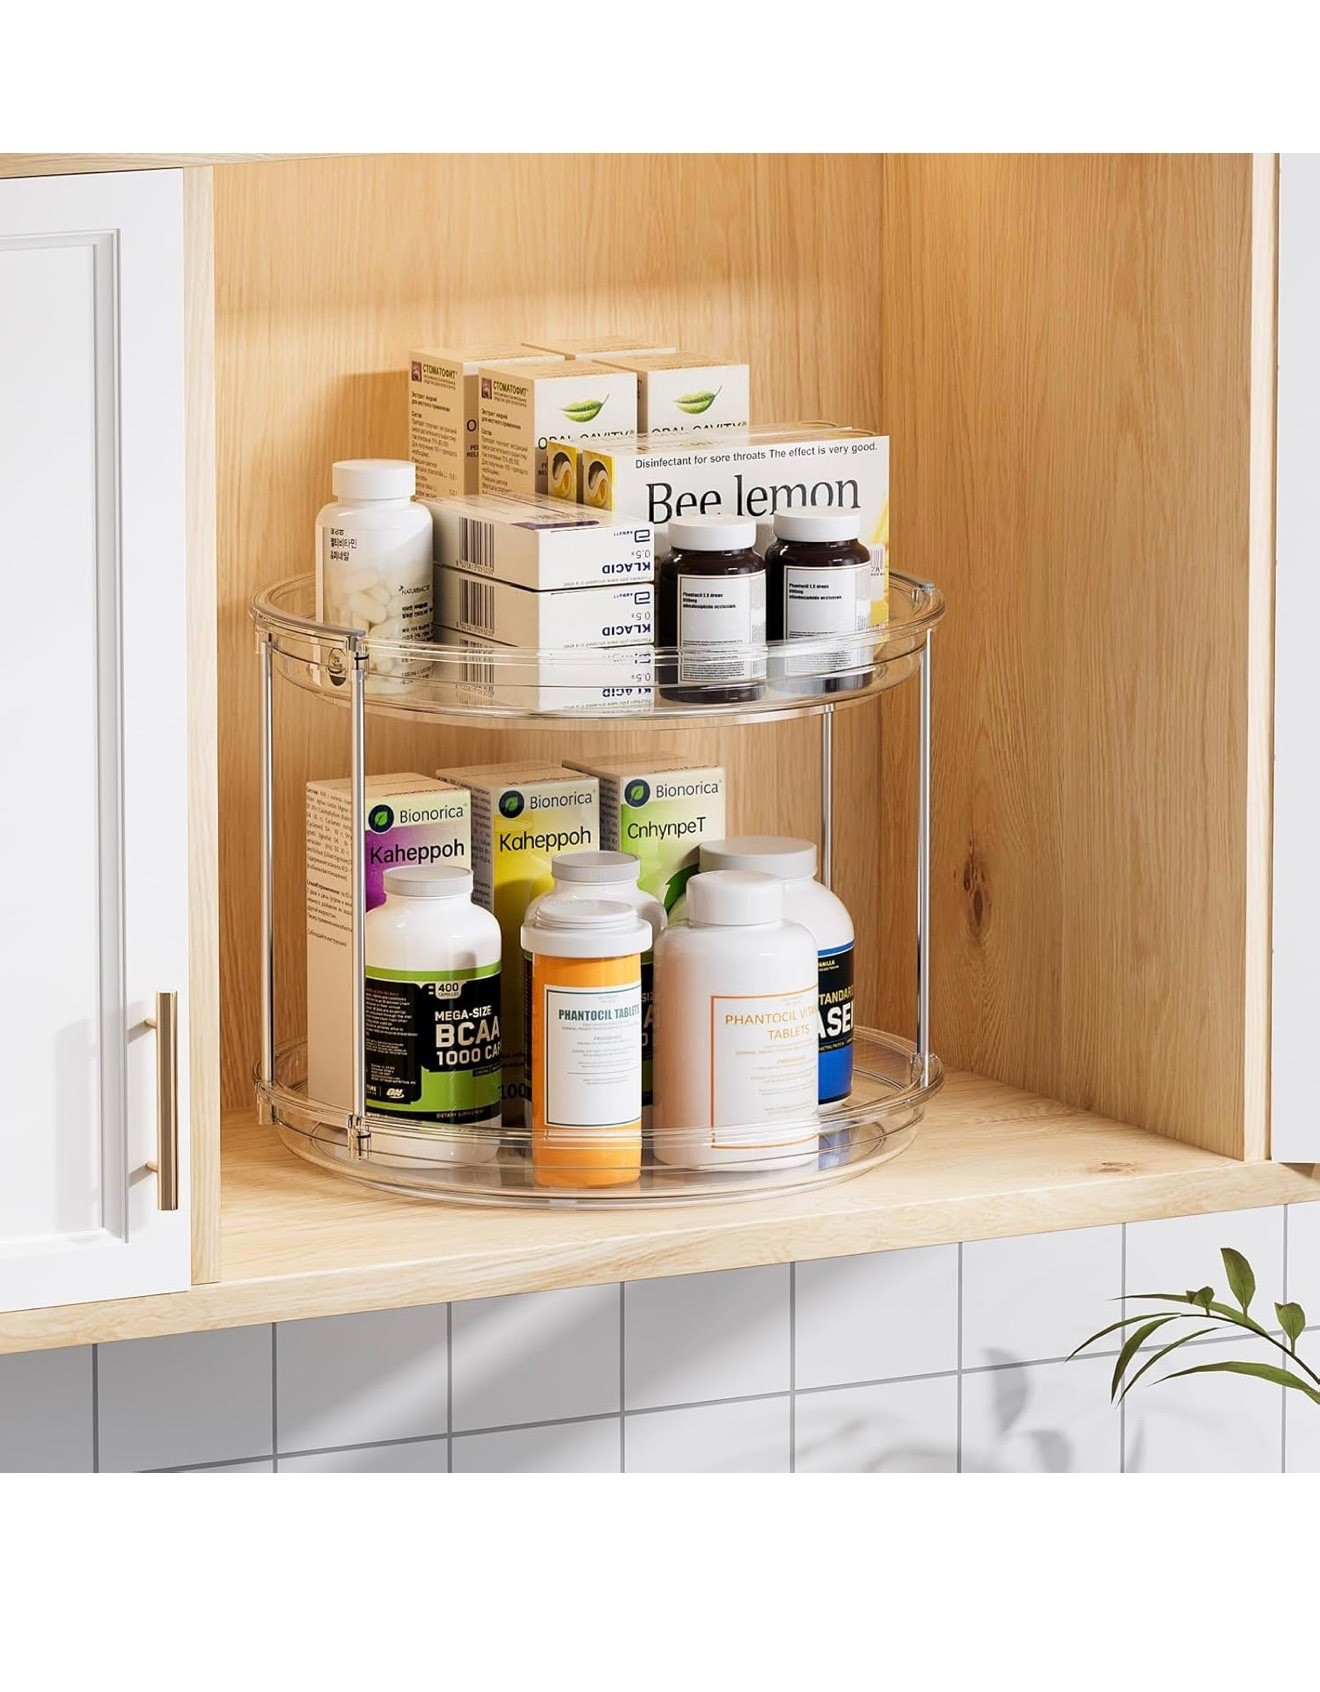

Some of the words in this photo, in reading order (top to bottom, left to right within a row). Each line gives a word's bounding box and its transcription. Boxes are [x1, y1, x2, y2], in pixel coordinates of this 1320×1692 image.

[636, 456, 692, 469] Disinfectant
[694, 454, 708, 465] for
[710, 454, 730, 463] sore
[733, 450, 766, 462] throats
[769, 448, 788, 458] The
[789, 446, 814, 457] effect
[818, 445, 826, 455] is
[829, 445, 848, 455] very
[852, 442, 878, 454] good.
[646, 482, 722, 525] Bee
[734, 474, 861, 516] lemon
[602, 562, 651, 574] KLACID
[602, 624, 651, 636] KLACID
[656, 781, 718, 798] Bionorica
[530, 792, 592, 810] Bionorica
[400, 805, 464, 824] Bionorica
[627, 817, 706, 840] CnhynpeT
[500, 826, 591, 852] Kaheppoh
[370, 839, 464, 864] Kaheppoh
[438, 983, 459, 992] 400
[434, 1005, 492, 1022] MEGA-SIZE
[558, 1009, 612, 1021] PHANTOCIL
[614, 1004, 640, 1020] TABLETS
[726, 1010, 797, 1025] PHANTOCIL
[435, 1016, 500, 1048] BCAA
[768, 1024, 810, 1040] TABLETS
[436, 1048, 480, 1066] 1000
